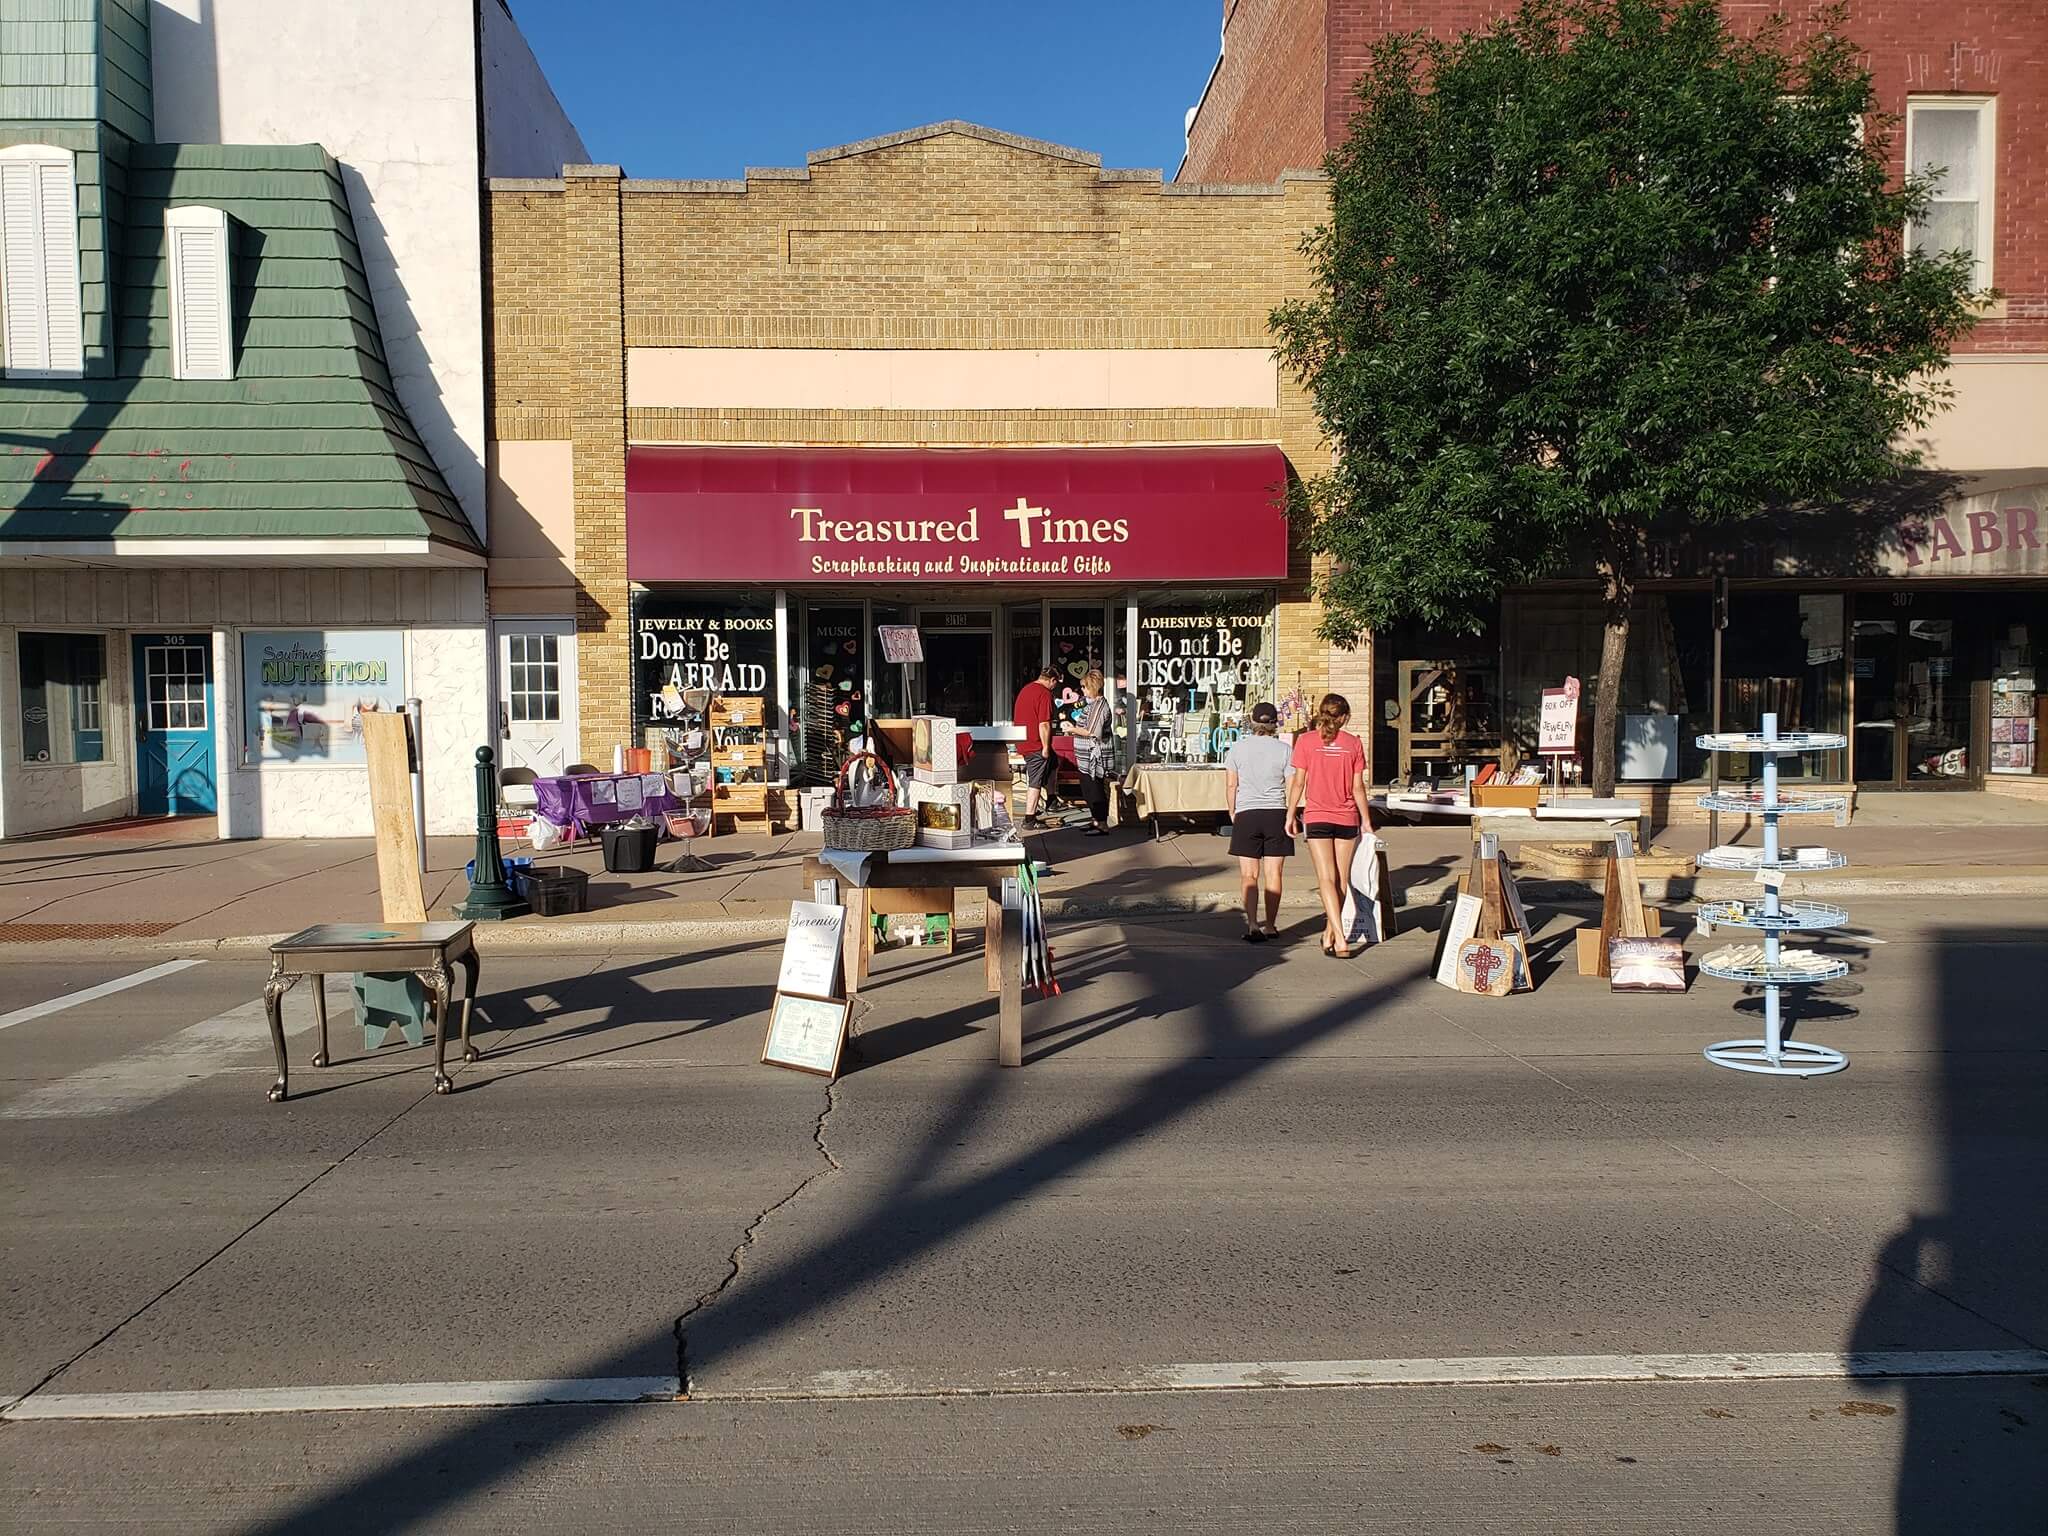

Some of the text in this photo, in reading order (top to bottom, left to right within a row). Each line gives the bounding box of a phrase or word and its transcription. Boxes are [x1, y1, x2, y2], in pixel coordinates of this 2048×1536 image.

[790, 507, 980, 543] Treasured
[811, 556, 1111, 577] Scrapbooking and Inspirational Gifts
[1892, 592, 1914, 606] 307
[638, 619, 773, 632] JEWELRY & BOOKS
[1141, 615, 1272, 629] ADHESIVES & TOOLS
[816, 627, 857, 637] MUSIC
[1052, 626, 1103, 637] ALBUMS
[163, 635, 185, 646] 305
[704, 633, 730, 661] Be
[1149, 630, 1172, 657] Do
[1180, 633, 1210, 656] not
[1216, 629, 1242, 656] Be
[263, 642, 336, 661] Southwest
[262, 660, 388, 685] NUTRITION
[670, 662, 767, 691] AFRAID
[1151, 687, 1180, 714] For
[1560, 700, 1575, 709] OFF
[1543, 721, 1574, 732] JEWELRY
[1555, 733, 1568, 741] ART
[791, 912, 841, 931] Serenity
